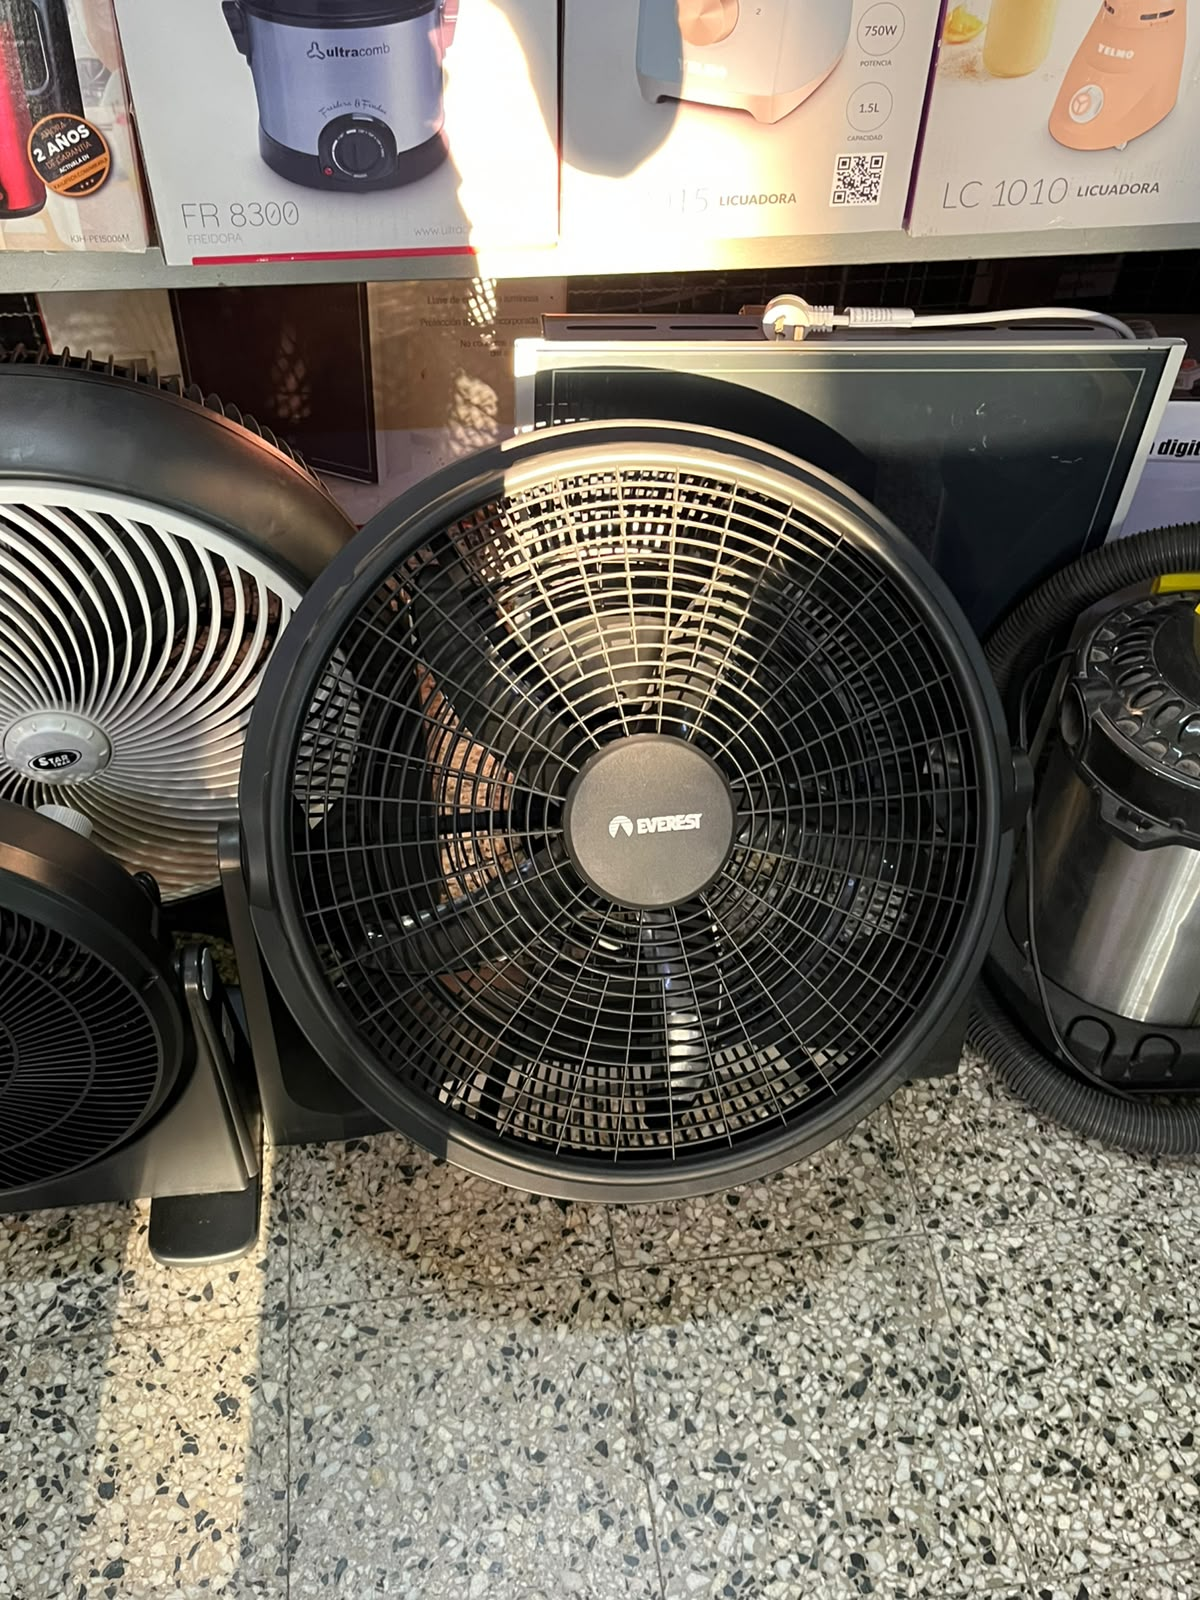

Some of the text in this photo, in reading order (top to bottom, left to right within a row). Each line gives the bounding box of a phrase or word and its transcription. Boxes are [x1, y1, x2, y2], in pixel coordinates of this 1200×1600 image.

[865, 25, 897, 36] 750W
[326, 43, 390, 58] ultracomb
[1098, 43, 1135, 60] TELMO
[859, 103, 880, 113] 1.5L
[33, 124, 90, 162] 2 AÑOS
[45, 159, 55, 170] DE
[719, 192, 797, 206] LICUADORA
[942, 177, 1159, 209] LC 1010 LICUADORA
[181, 201, 299, 228] FR 8300
[187, 233, 243, 245] FREIDORA
[38, 754, 70, 767] STAR
[637, 813, 702, 834] EVEREST
